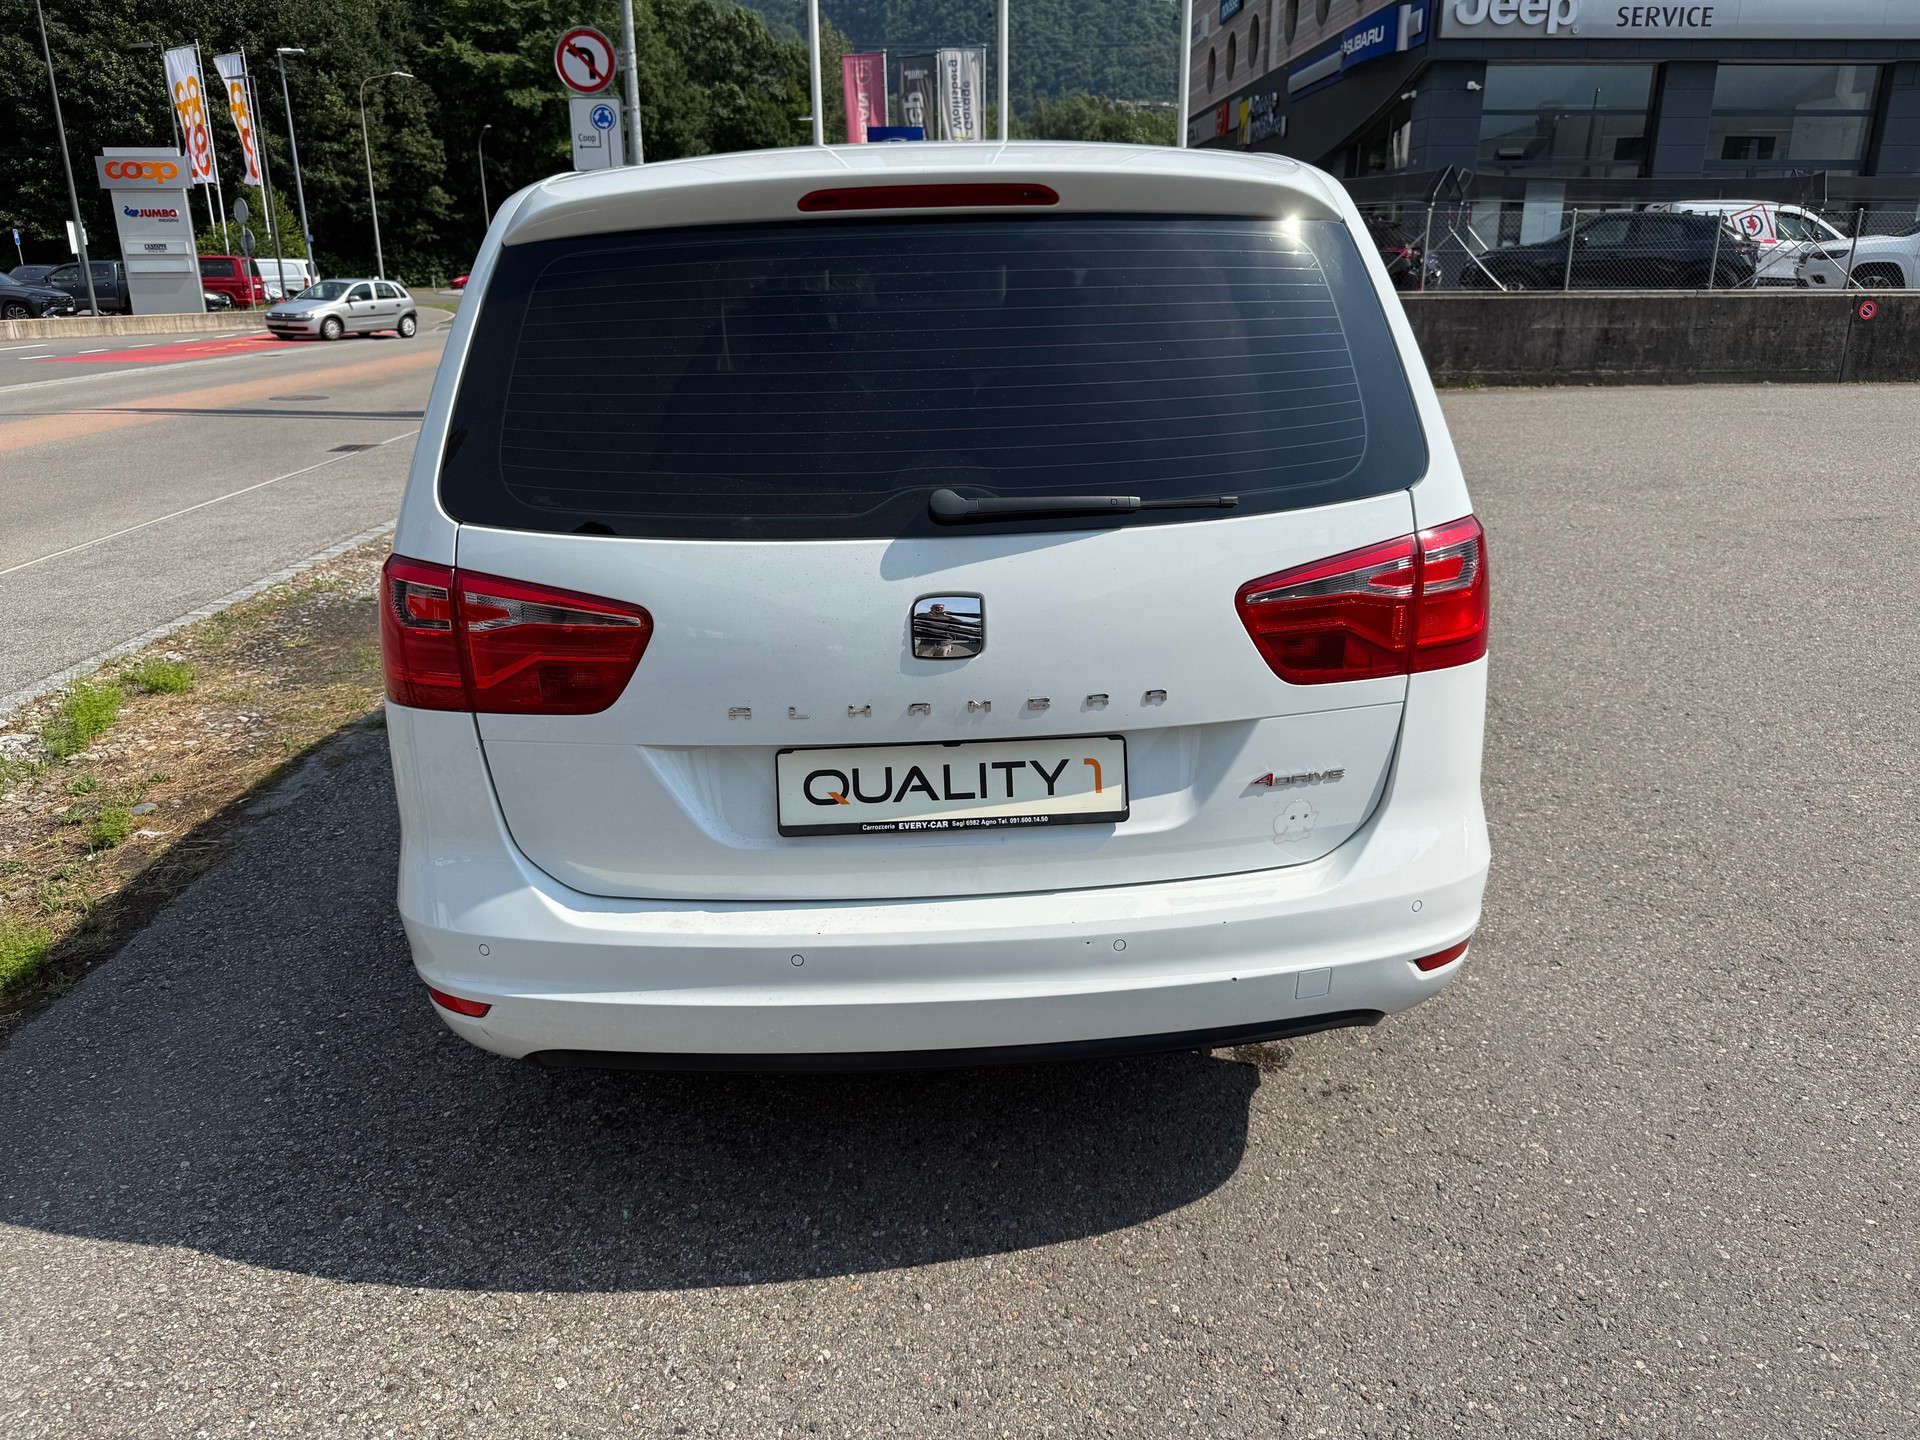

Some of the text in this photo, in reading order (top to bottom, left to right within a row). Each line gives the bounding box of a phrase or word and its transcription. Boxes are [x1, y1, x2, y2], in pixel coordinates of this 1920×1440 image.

[1455, 0, 1578, 34] Jeep
[1616, 6, 1714, 27] SERVICE
[1346, 25, 1385, 55] SUBARU
[578, 133, 596, 144] Coop
[104, 161, 178, 184] coop
[139, 208, 177, 218] JUMBO
[728, 689, 1167, 720] ALHAMBRA
[803, 757, 1103, 806] QUALITY 1
[1253, 768, 1346, 787] 4DRIVE
[862, 823, 895, 831] Carrozzeria
[898, 820, 949, 831] EVERY-CAR
[981, 818, 997, 827] Agno
